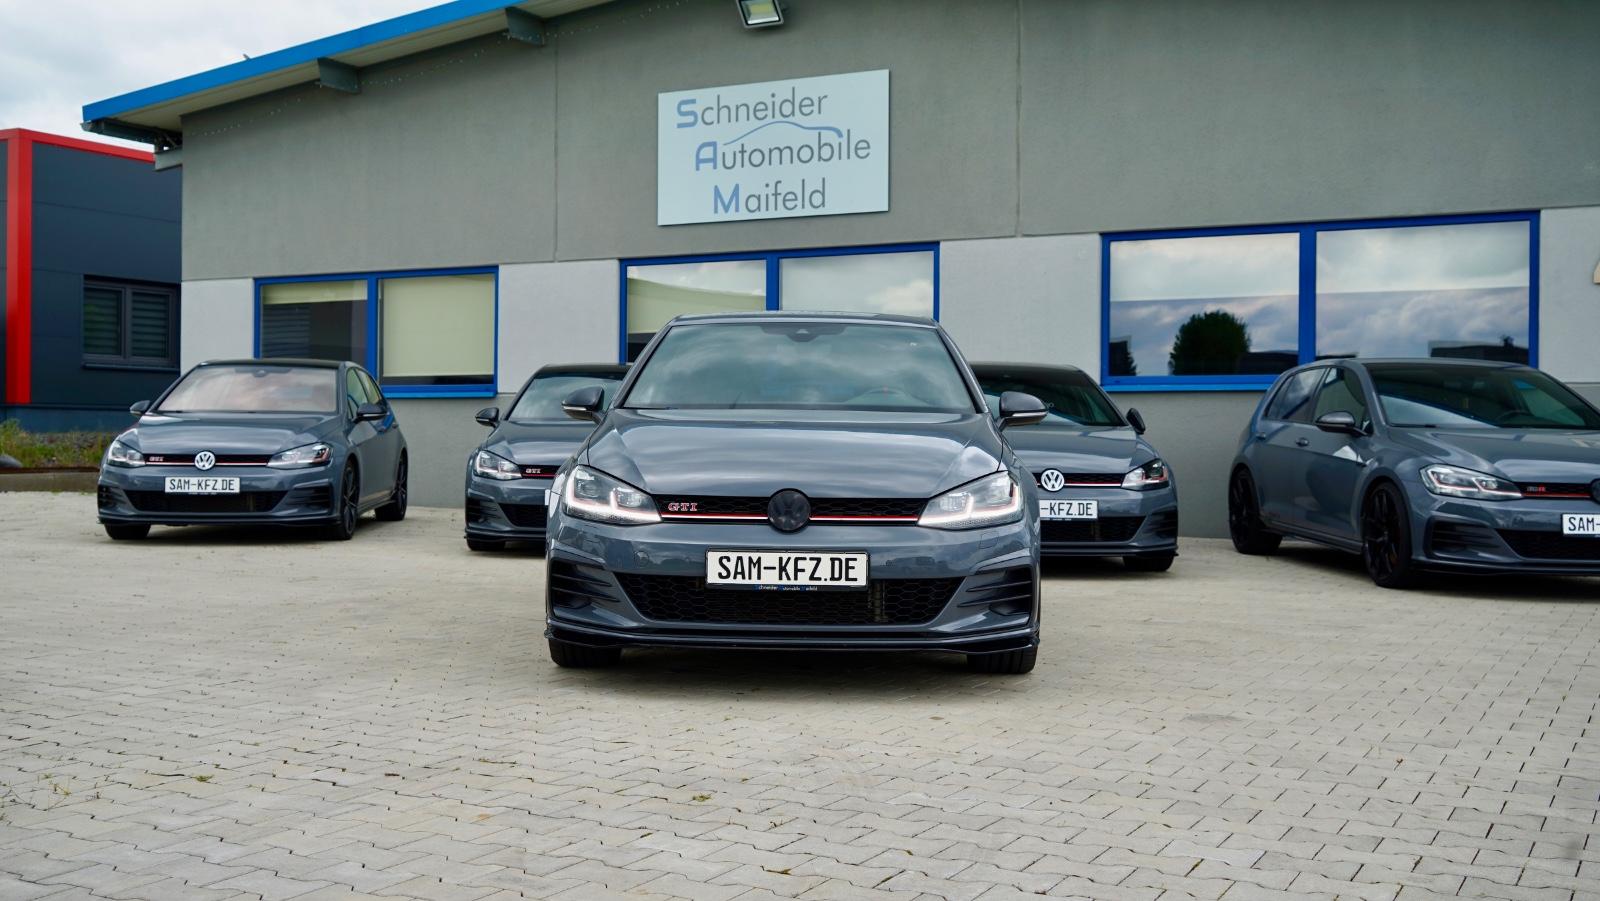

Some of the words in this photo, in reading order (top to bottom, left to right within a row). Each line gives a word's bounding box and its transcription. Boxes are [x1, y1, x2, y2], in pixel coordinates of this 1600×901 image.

[677, 86, 828, 128] Schneider
[695, 129, 871, 171] Automobile
[713, 177, 826, 214] Maifeld
[169, 478, 235, 491] SAM-KFZ.DE
[667, 502, 698, 511] GTI
[717, 555, 858, 582] SAM-KFZ.DE
